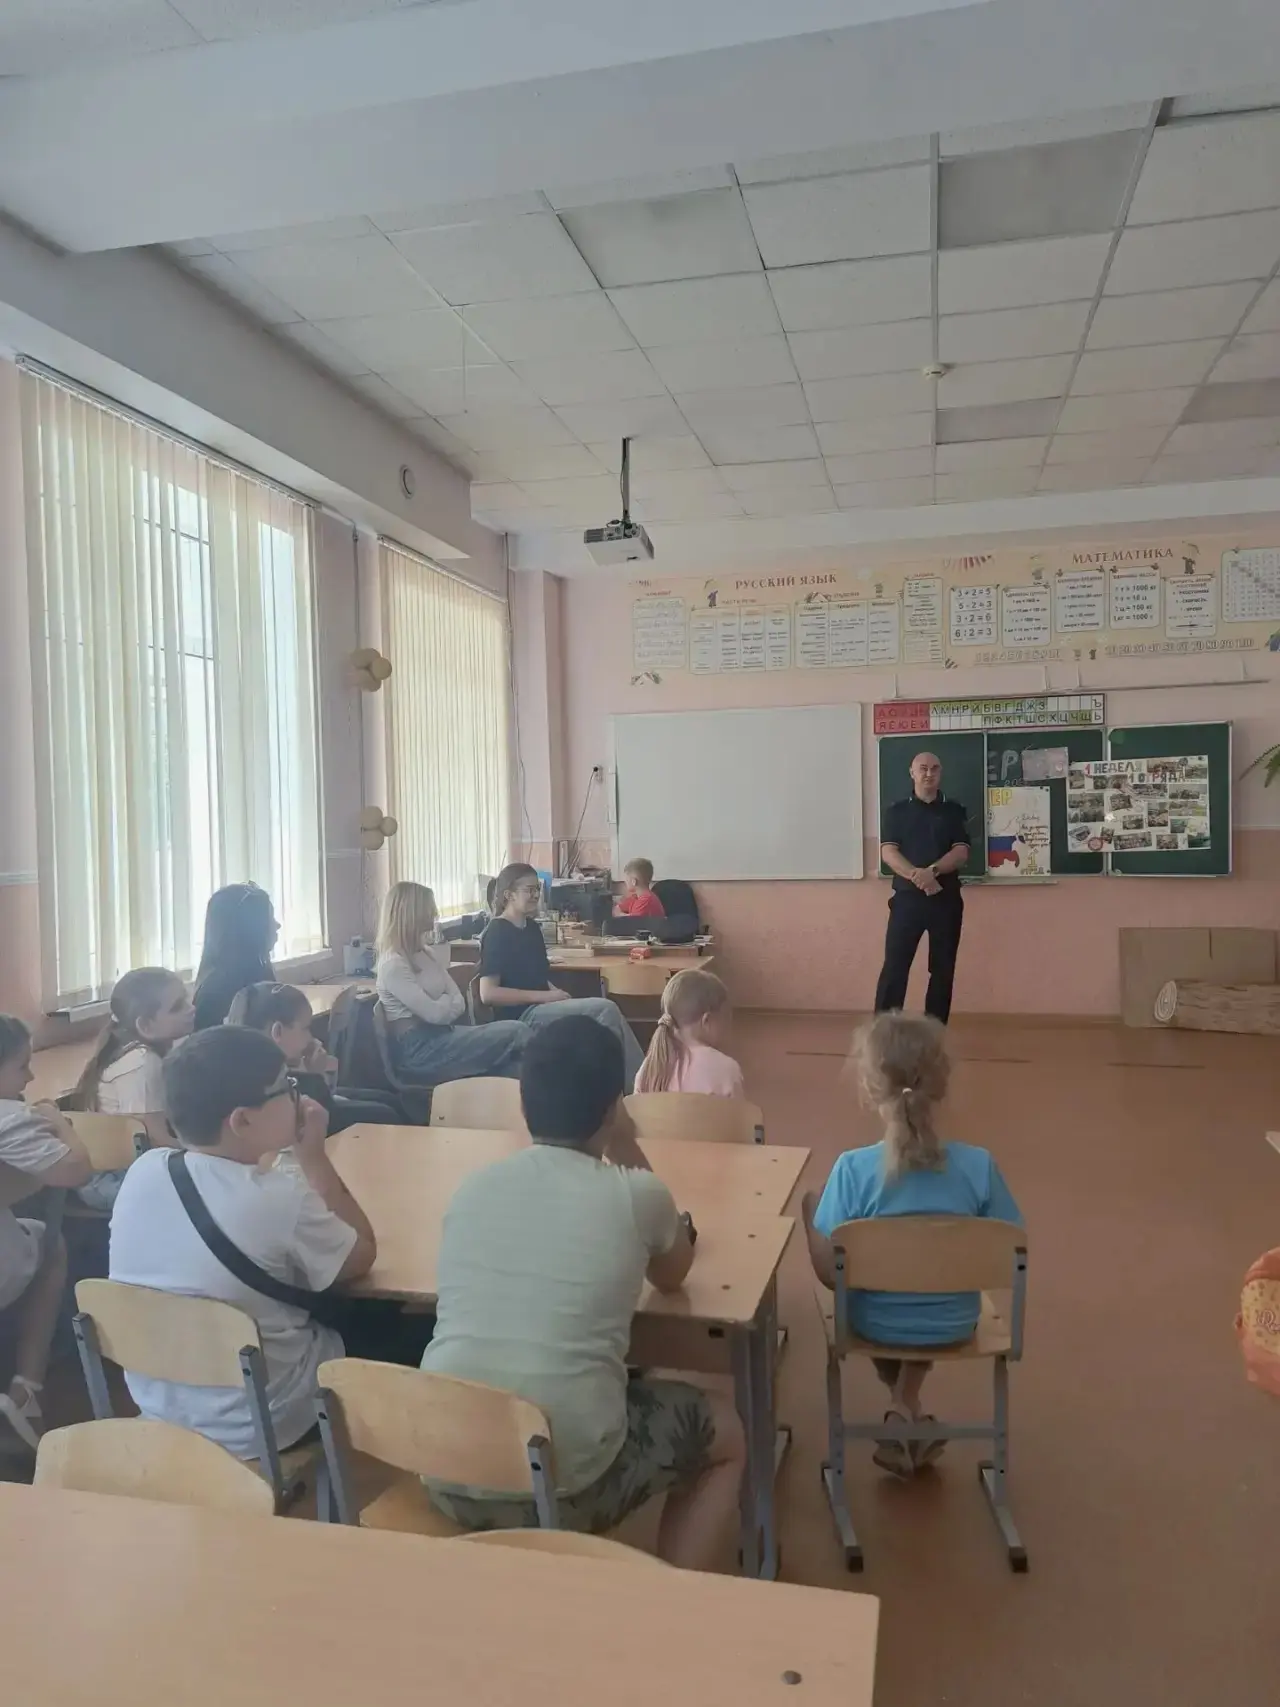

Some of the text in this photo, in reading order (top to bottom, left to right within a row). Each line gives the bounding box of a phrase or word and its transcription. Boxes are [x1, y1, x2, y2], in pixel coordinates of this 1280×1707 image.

[1072, 548, 1174, 565] МАТЕМАТИКА
[735, 574, 837, 590] РУССКИЙ ЯЗЫК
[955, 629, 961, 637] 6
[969, 628, 975, 636] 2
